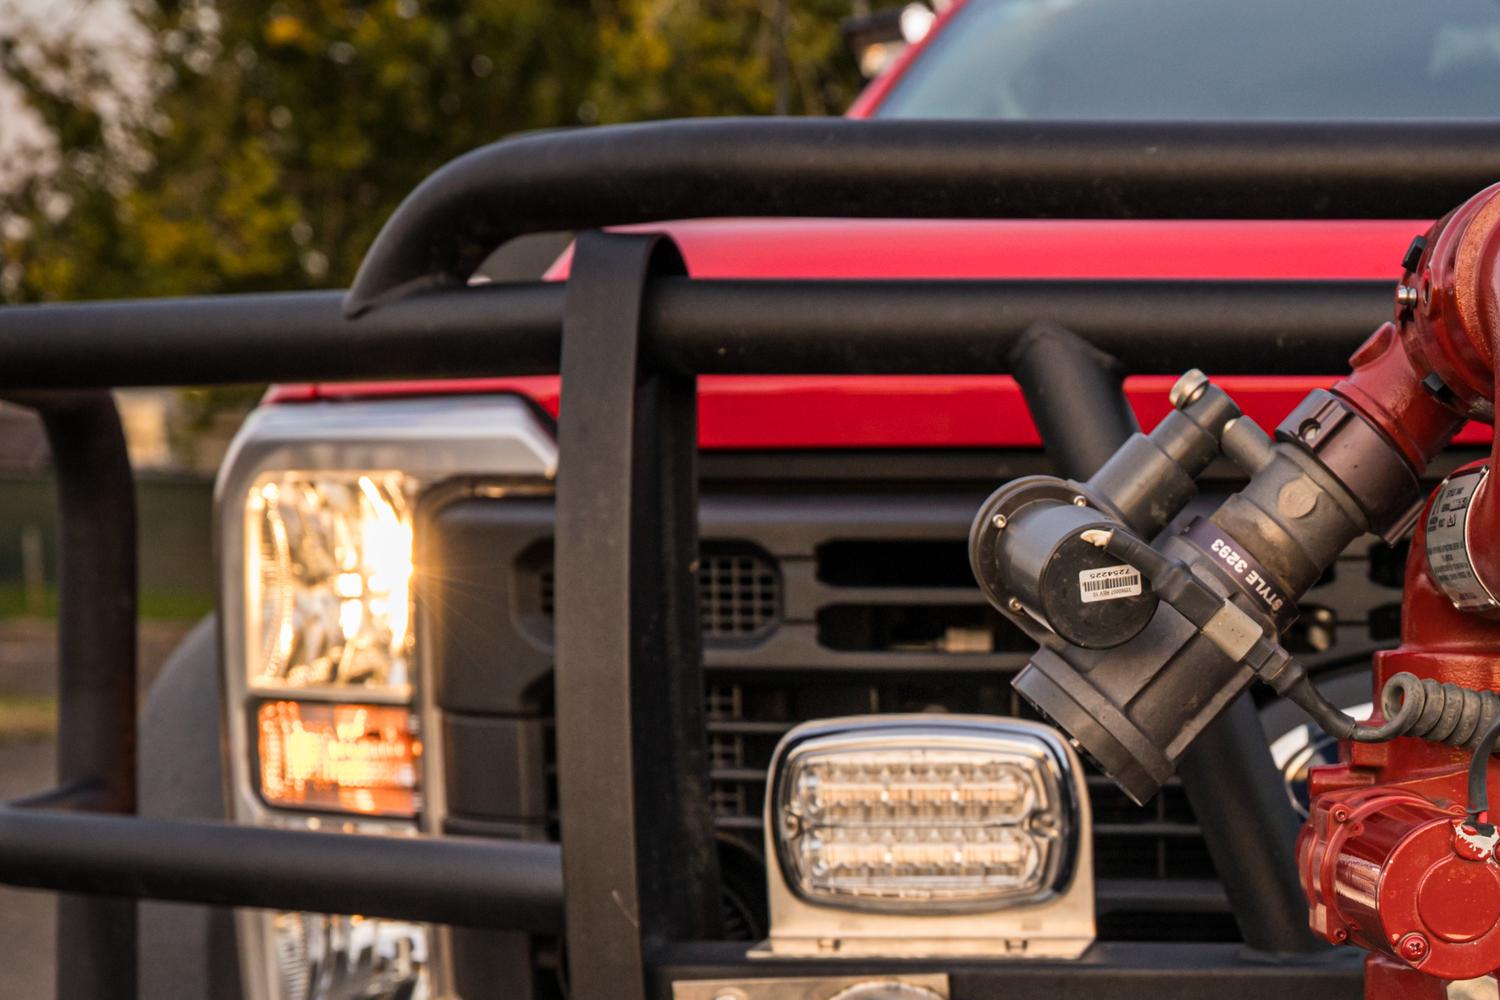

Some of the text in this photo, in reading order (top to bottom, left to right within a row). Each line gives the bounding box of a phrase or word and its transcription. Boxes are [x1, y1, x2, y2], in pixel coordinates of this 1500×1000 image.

[1090, 568, 1130, 579] 7254225
[1211, 538, 1284, 611] STYLE 3293
